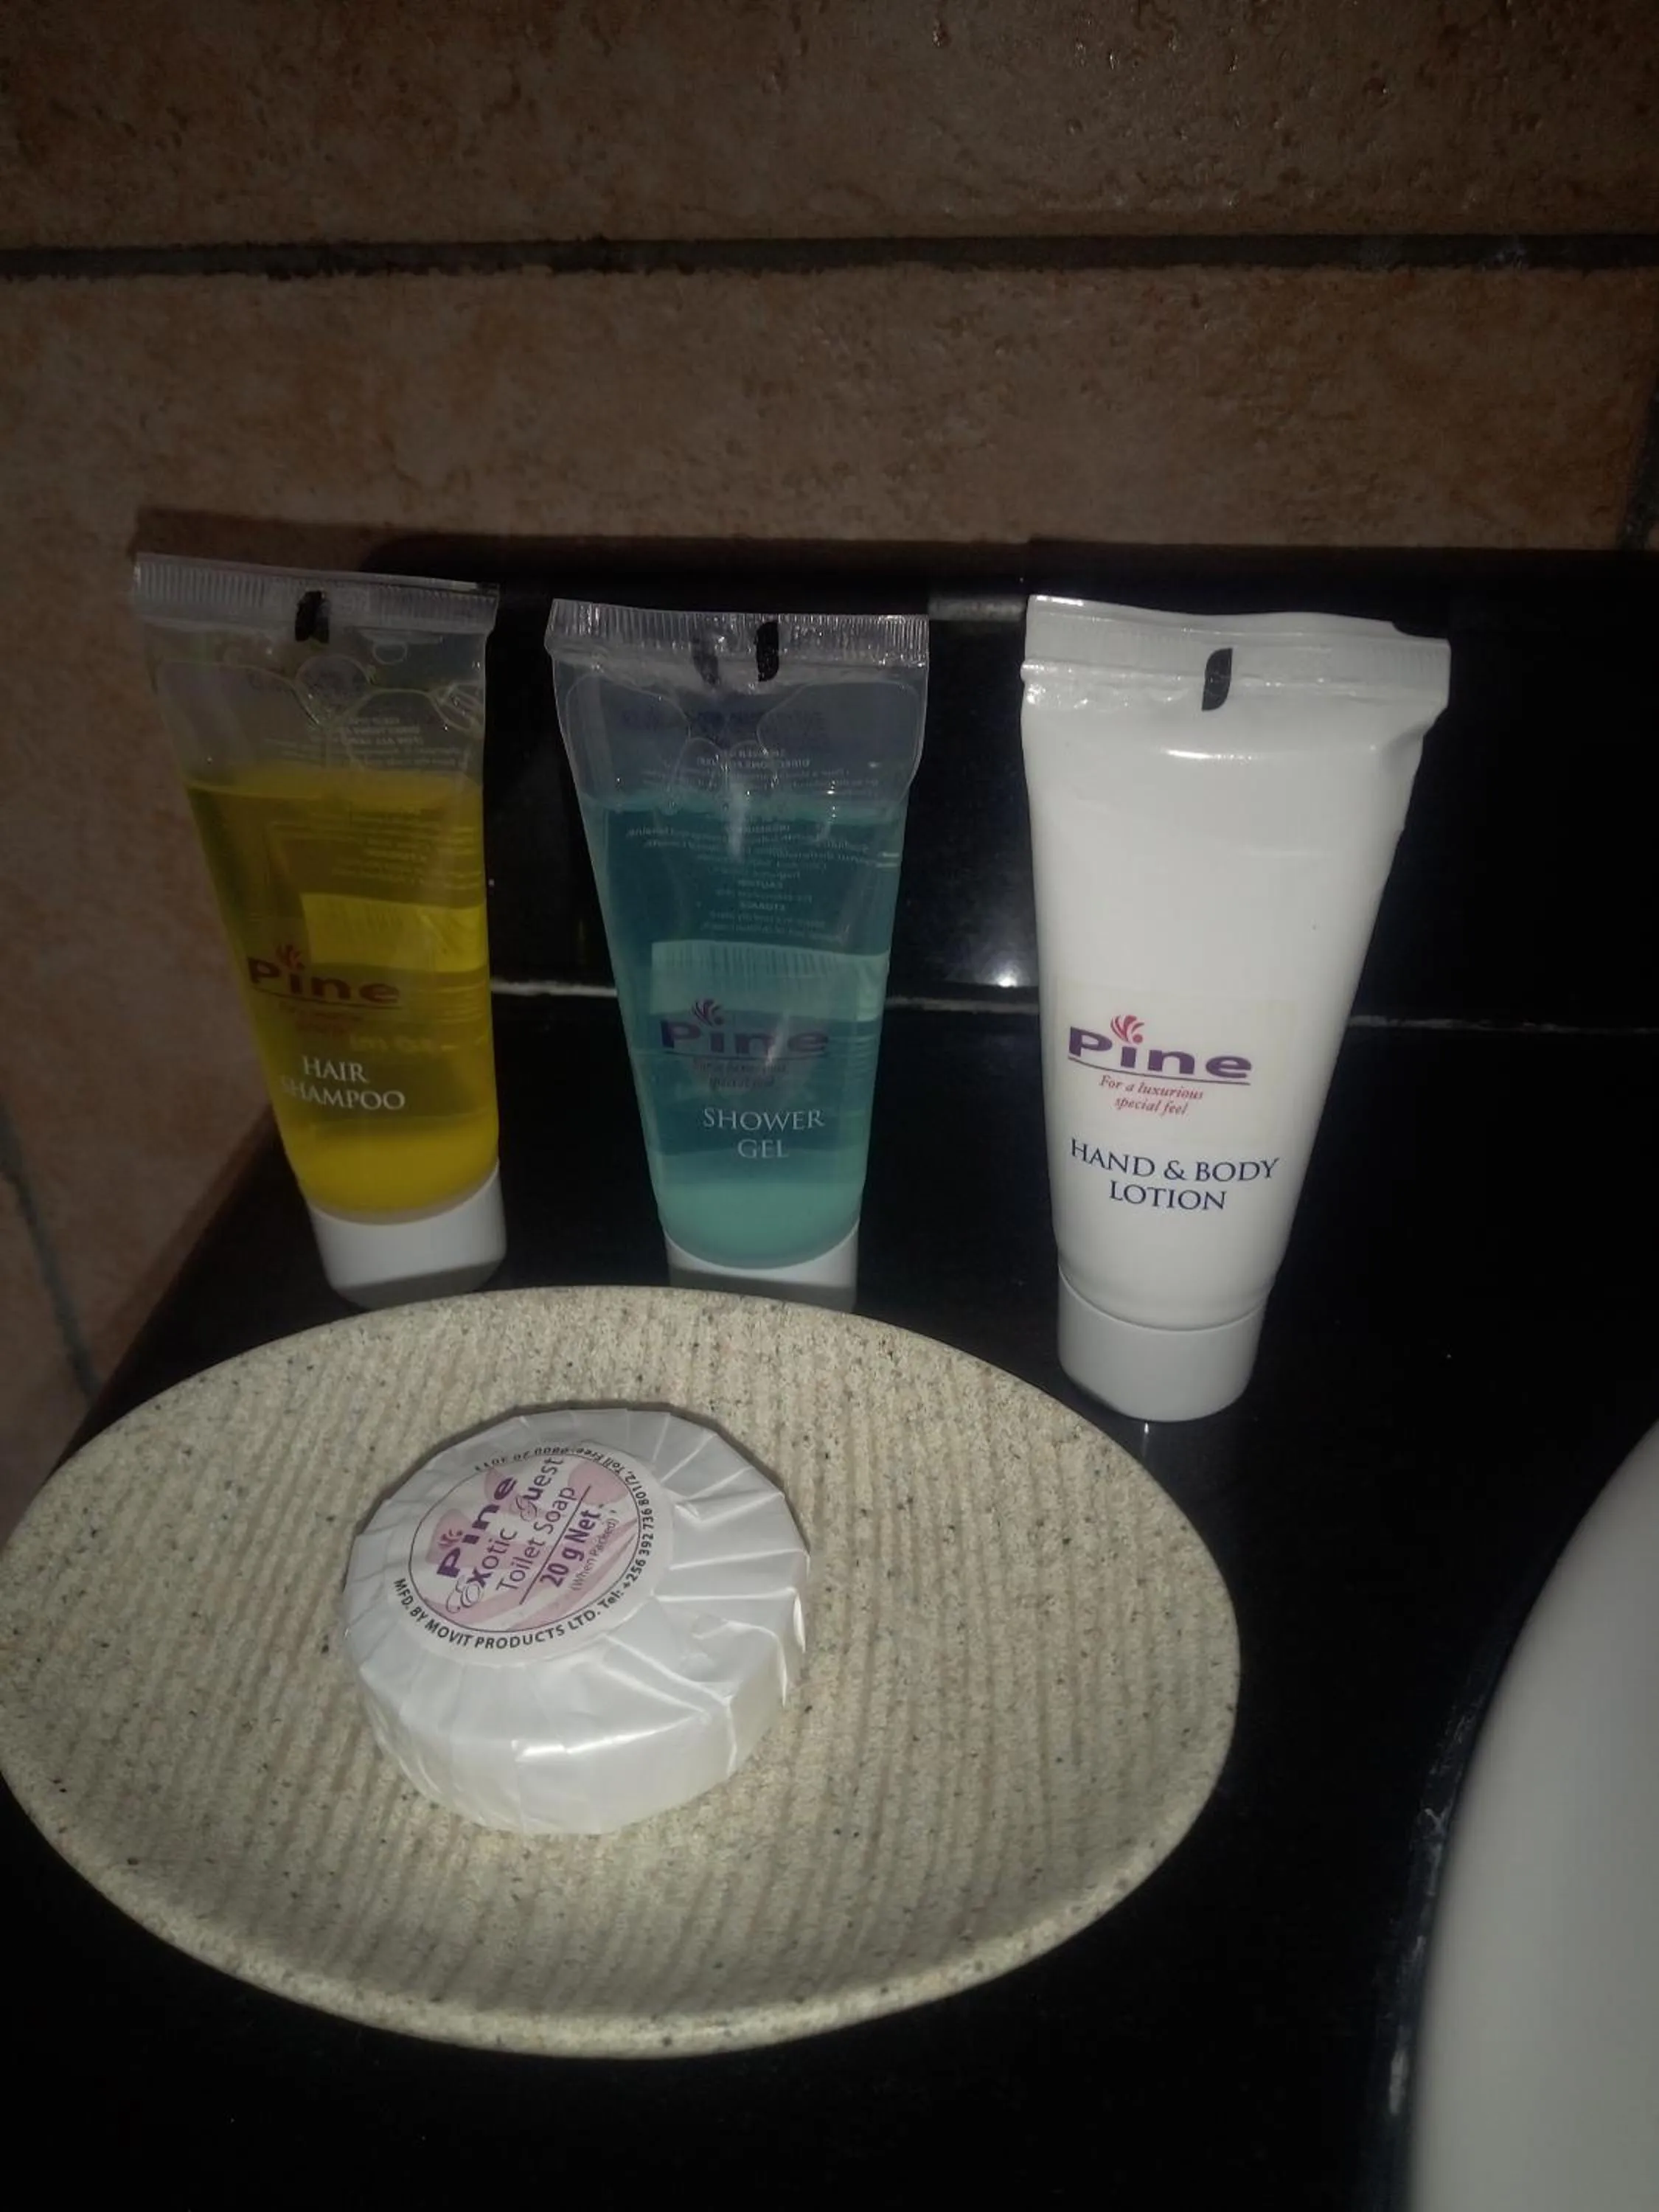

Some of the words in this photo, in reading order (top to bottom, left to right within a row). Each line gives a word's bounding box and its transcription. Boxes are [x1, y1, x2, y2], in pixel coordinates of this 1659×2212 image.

[248, 956, 400, 1004] Pine
[660, 1020, 829, 1054] Pine
[1068, 1025, 1252, 1079] Pine
[302, 1055, 368, 1084] HAIR
[1099, 1074, 1123, 1089] For
[1125, 1082, 1134, 1092] a
[1137, 1082, 1204, 1100] luxurious
[703, 1107, 826, 1132] SHOWER
[1114, 1097, 1161, 1113] special
[1161, 1099, 1189, 1117] feel
[737, 1138, 790, 1159] GEL
[1071, 1138, 1155, 1178] HAND
[1164, 1160, 1187, 1180] &
[1194, 1157, 1280, 1182] BODY
[1108, 1180, 1228, 1211] LOTION
[600, 1457, 625, 1475] Toll
[437, 1476, 518, 1579] Pine
[563, 1509, 602, 1544] Net
[641, 1508, 655, 1530] 736
[495, 1536, 546, 1591] Toilet
[533, 1486, 577, 1534] Soap
[639, 1533, 654, 1557] 392
[561, 1547, 585, 1562] g
[540, 1562, 570, 1588] 20
[622, 1558, 647, 1589] +256
[597, 1590, 625, 1609] Tel:
[409, 1605, 429, 1624] BY
[568, 1609, 602, 1631] LTD.
[425, 1618, 473, 1648] MOVIT
[474, 1624, 566, 1650] PRODUCTS
